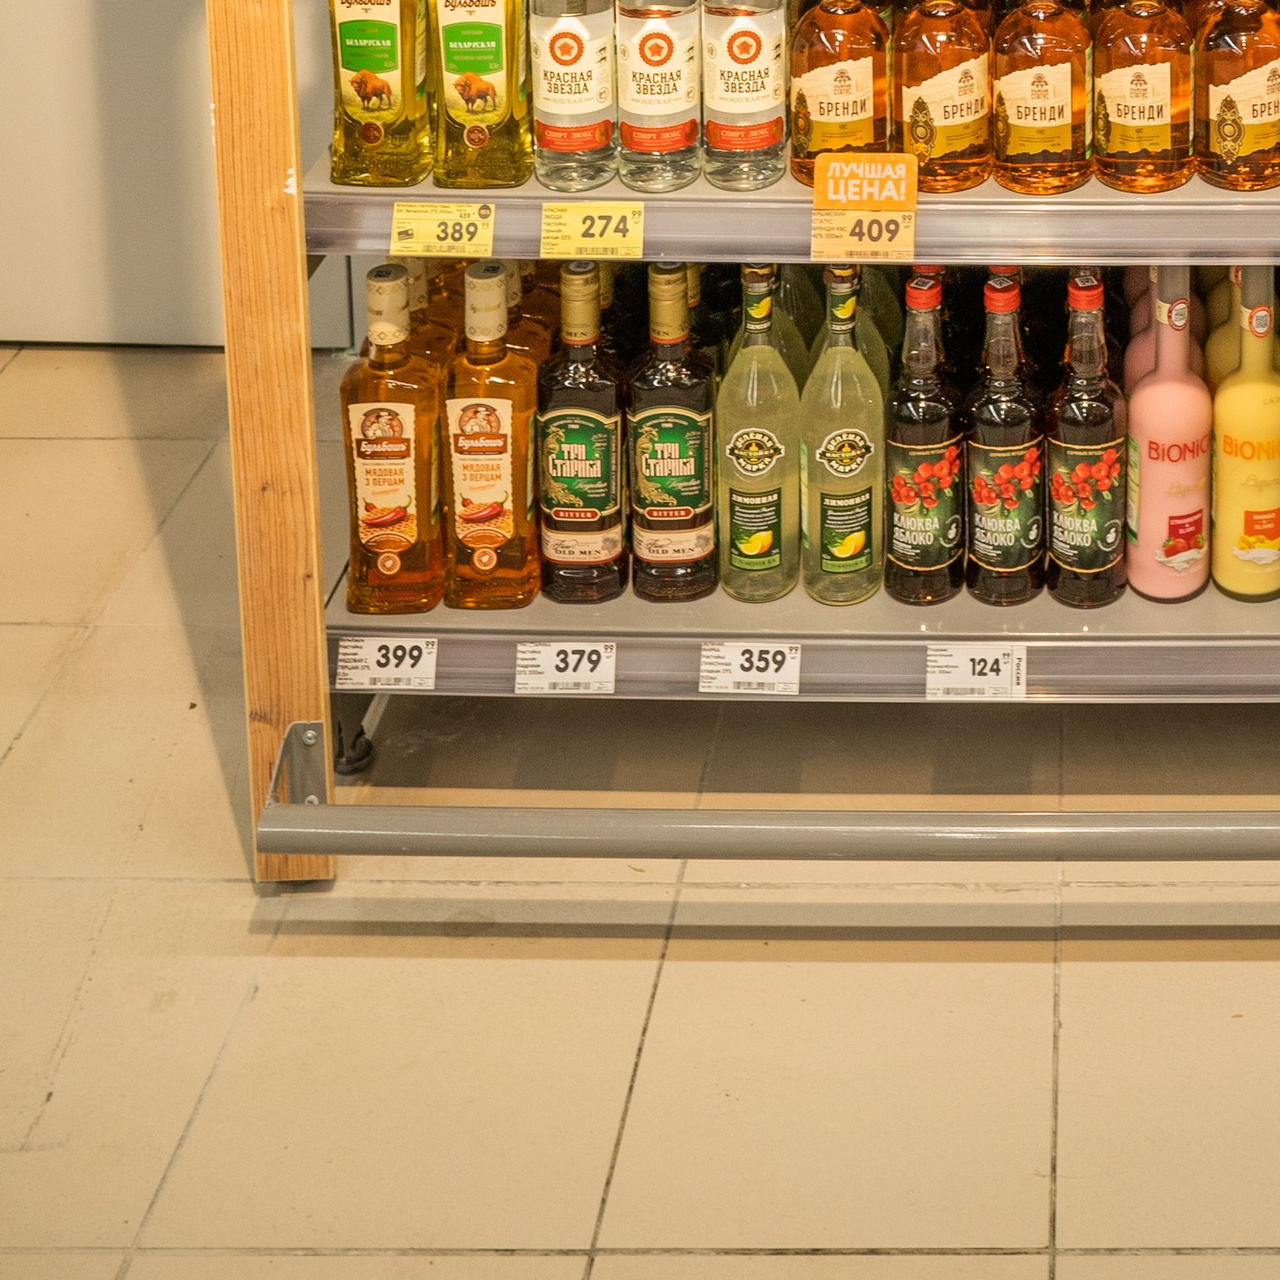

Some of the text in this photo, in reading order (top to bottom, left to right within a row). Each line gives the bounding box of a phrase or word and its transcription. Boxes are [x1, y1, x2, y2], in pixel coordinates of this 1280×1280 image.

[544, 69, 592, 83] КРАСНАЯ
[632, 69, 682, 83] КРАСНАЯ
[547, 82, 589, 93] ЗВЕЗДА
[636, 82, 678, 94] ЗВЕЗДА
[819, 99, 867, 117] БРЕНДИ
[1116, 104, 1164, 120] БРЕНДИ
[827, 162, 906, 180] ЛУЧШАЯ
[828, 180, 907, 204] ЦЕНА!
[436, 223, 478, 241] 389
[581, 216, 629, 239] 274
[849, 219, 900, 242] 409
[731, 495, 778, 505] ЛИМОННАЯ
[559, 511, 592, 519] BITTER
[894, 513, 939, 531] КЛЮКВА
[893, 529, 933, 546] ЯБЛОКО
[555, 548, 601, 557] OLD MEN
[375, 646, 423, 669] 399
[554, 651, 601, 673] 379
[740, 651, 786, 673] 359
[970, 658, 1001, 676] 124
[1015, 657, 1023, 686] Россия
